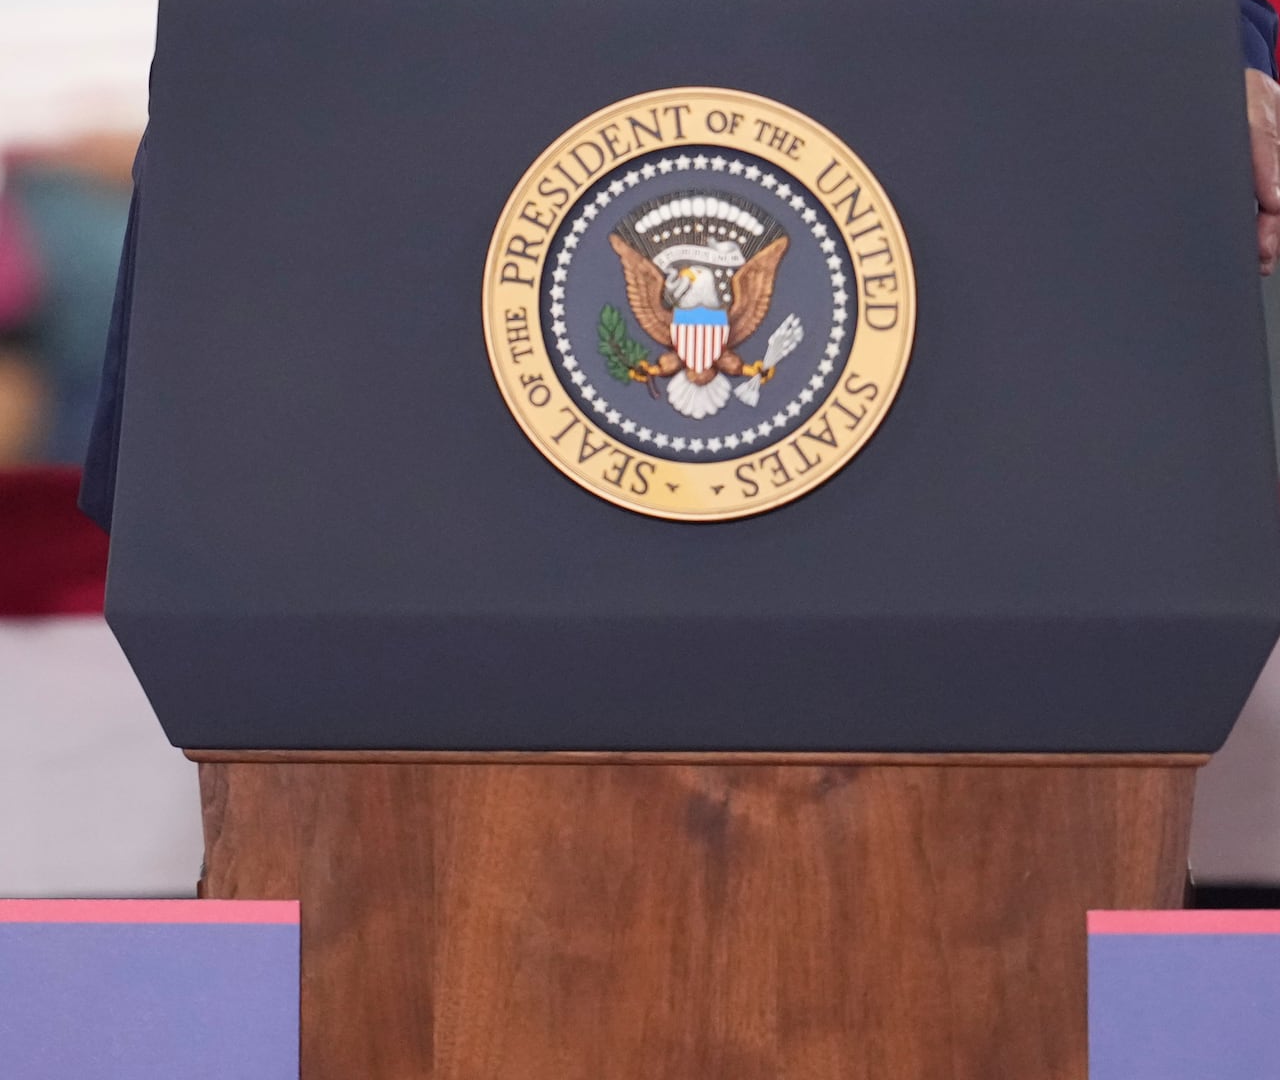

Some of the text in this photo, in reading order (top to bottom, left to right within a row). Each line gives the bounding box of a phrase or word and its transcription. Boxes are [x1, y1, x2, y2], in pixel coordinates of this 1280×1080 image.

[500, 104, 899, 499] SEAL OF THE PRESIDENT OF THE UNITED STATES
